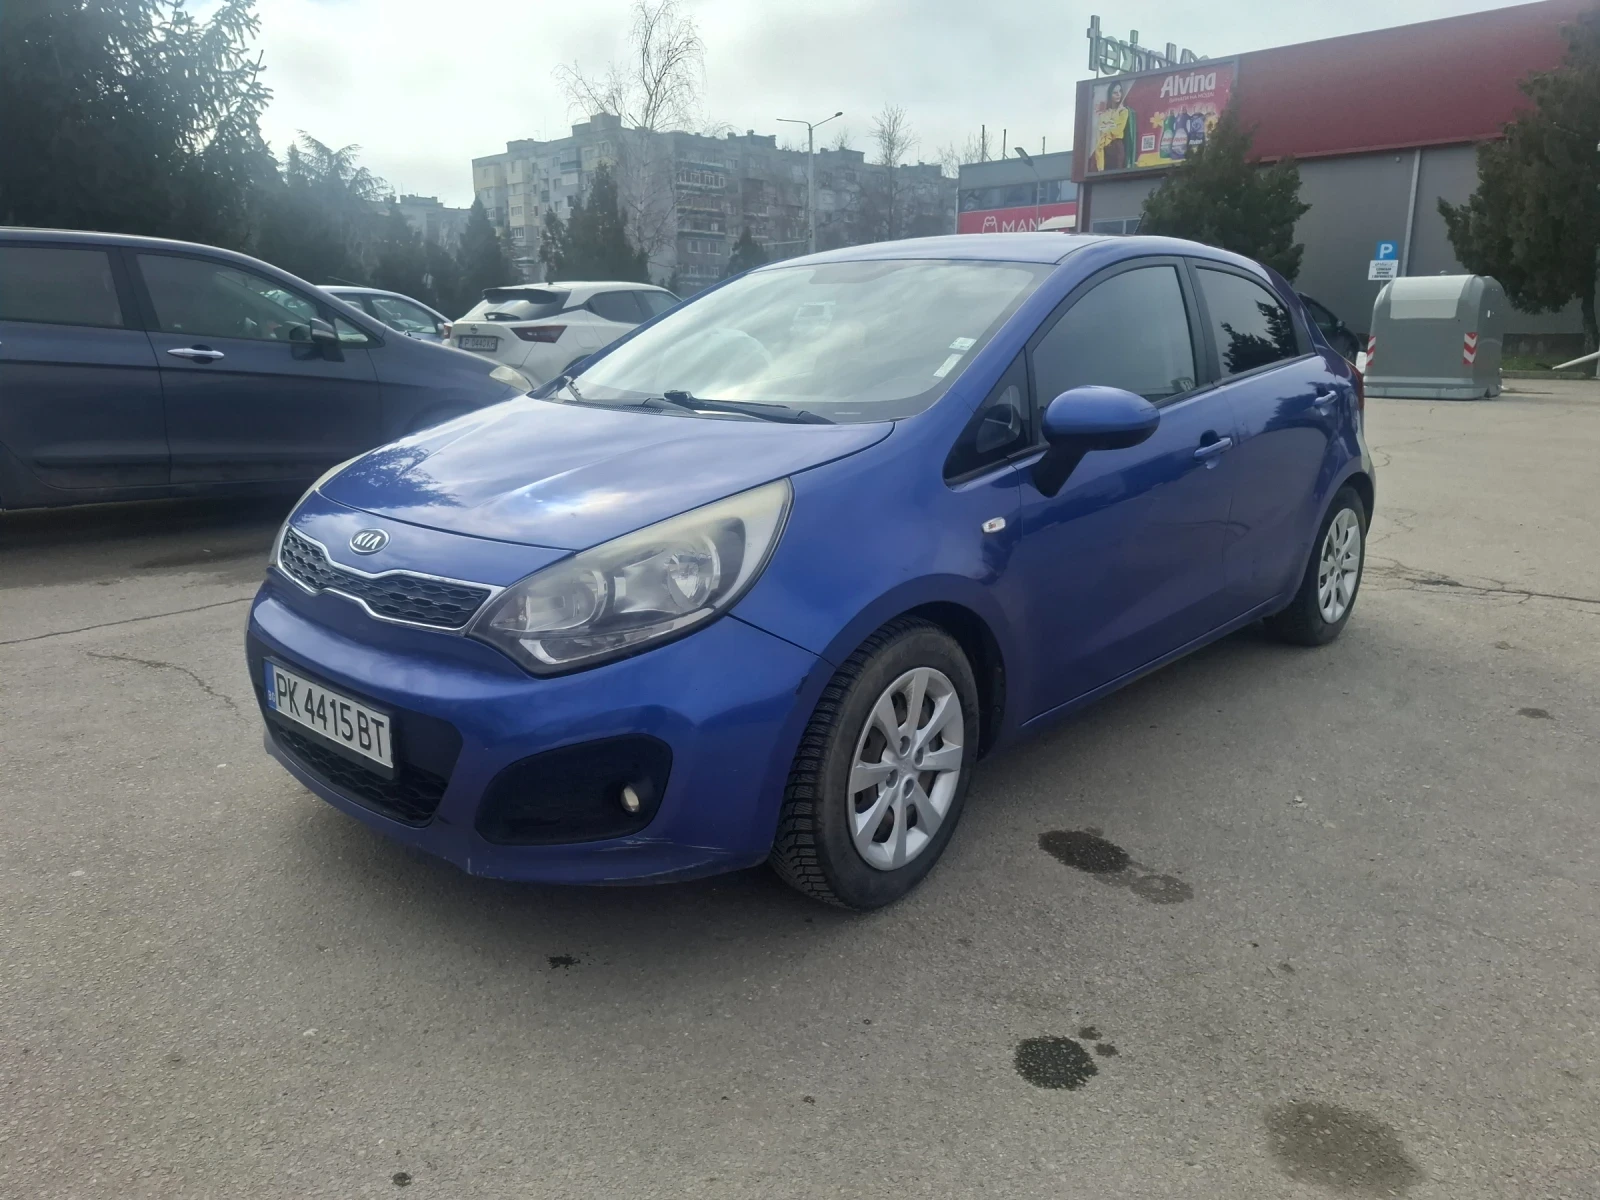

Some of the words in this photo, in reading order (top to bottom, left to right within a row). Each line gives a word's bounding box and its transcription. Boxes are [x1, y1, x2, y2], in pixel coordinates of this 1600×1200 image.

[1160, 72, 1217, 98] Alvina
[1379, 243, 1393, 259] P
[354, 532, 382, 549] KIA
[275, 671, 301, 717] PK
